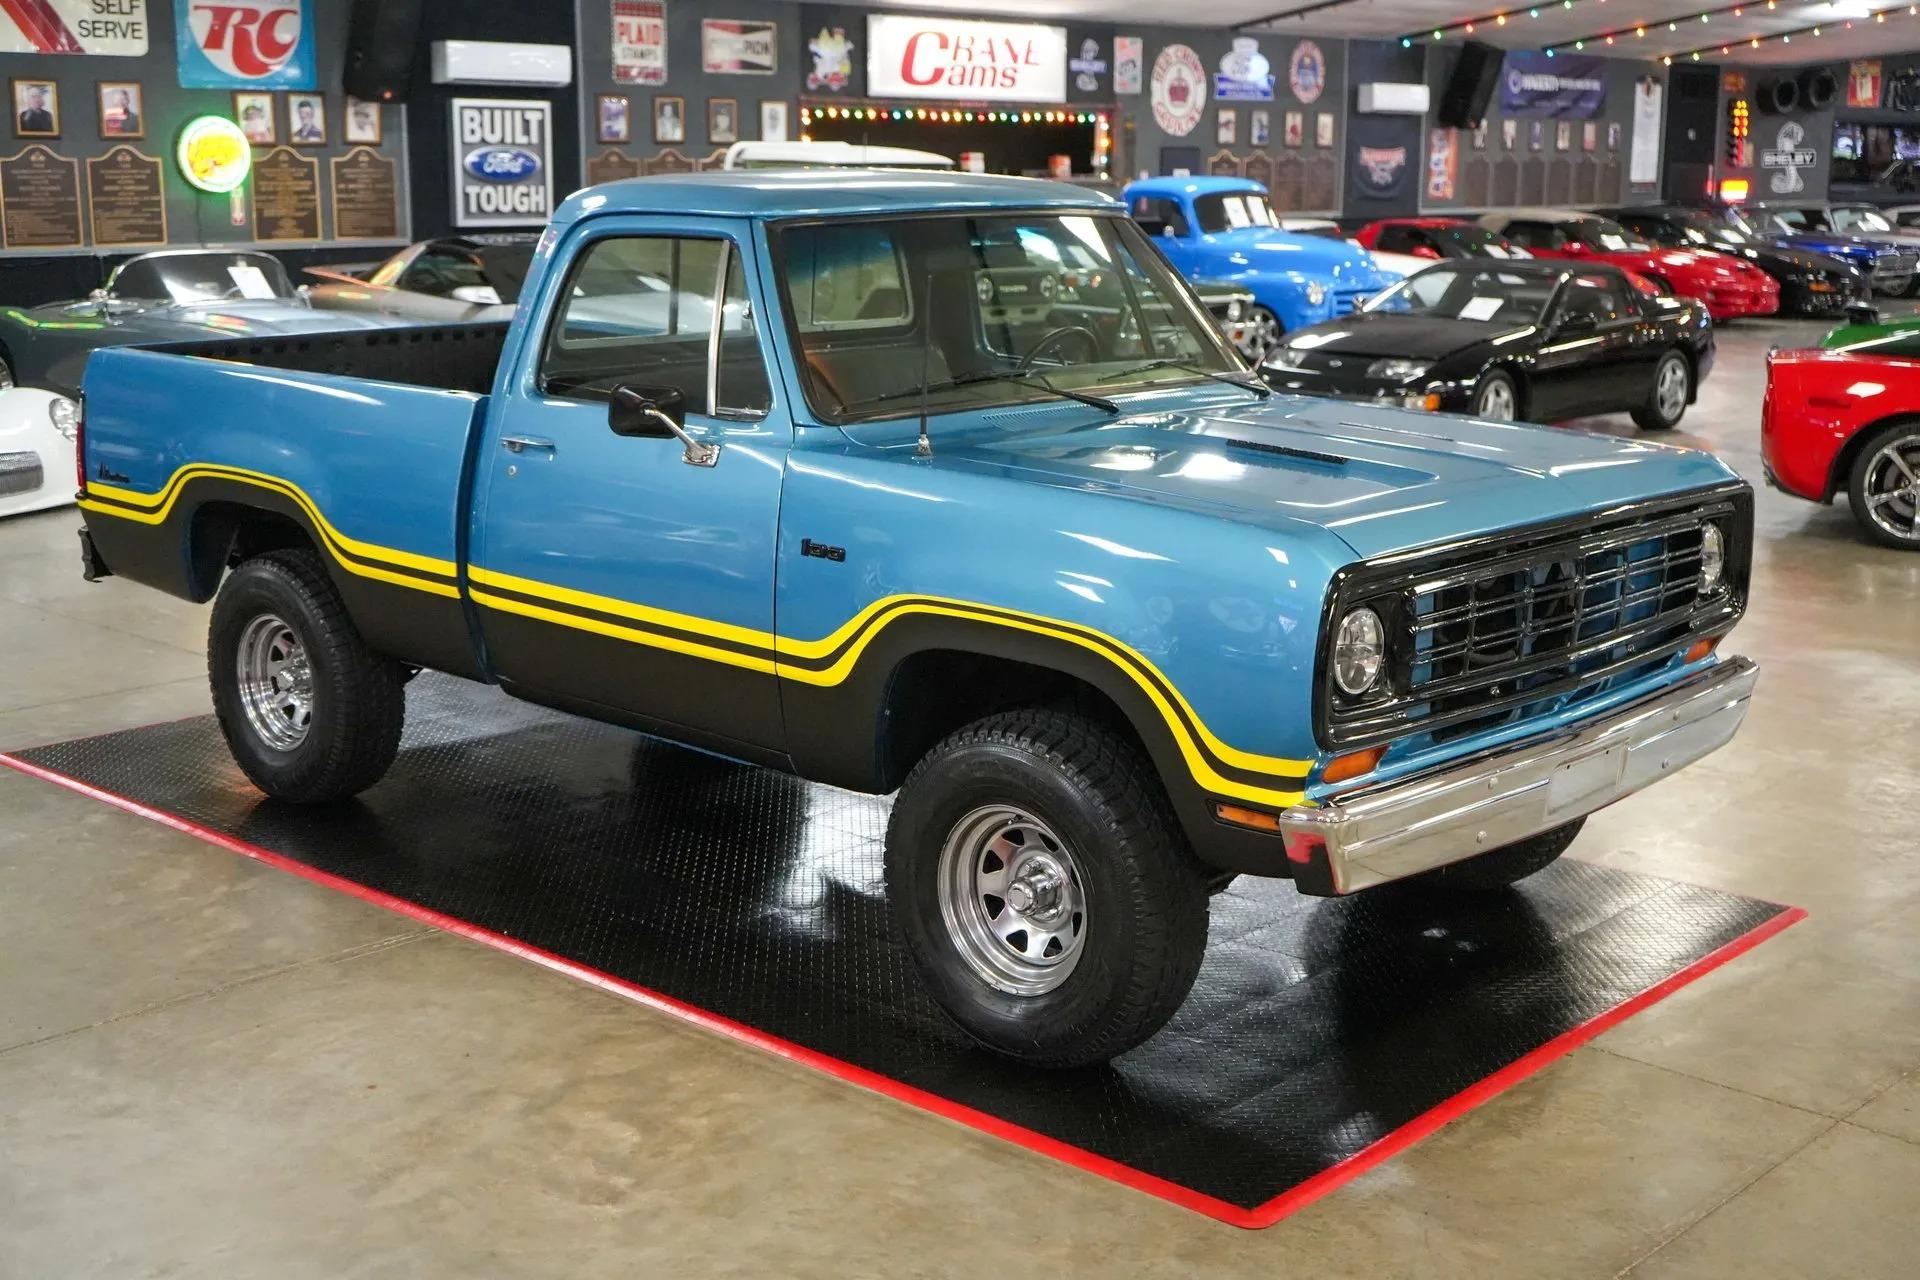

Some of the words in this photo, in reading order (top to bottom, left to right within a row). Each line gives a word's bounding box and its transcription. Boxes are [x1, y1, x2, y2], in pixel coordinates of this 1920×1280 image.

[92, 0, 140, 15] SELF
[78, 20, 143, 40] SERVE
[193, 5, 298, 76] RC
[617, 21, 660, 46] PLAID
[901, 31, 1039, 86] CRANE
[461, 108, 543, 144] BUILT
[482, 150, 526, 174] Ford
[464, 185, 545, 213] TOUGH
